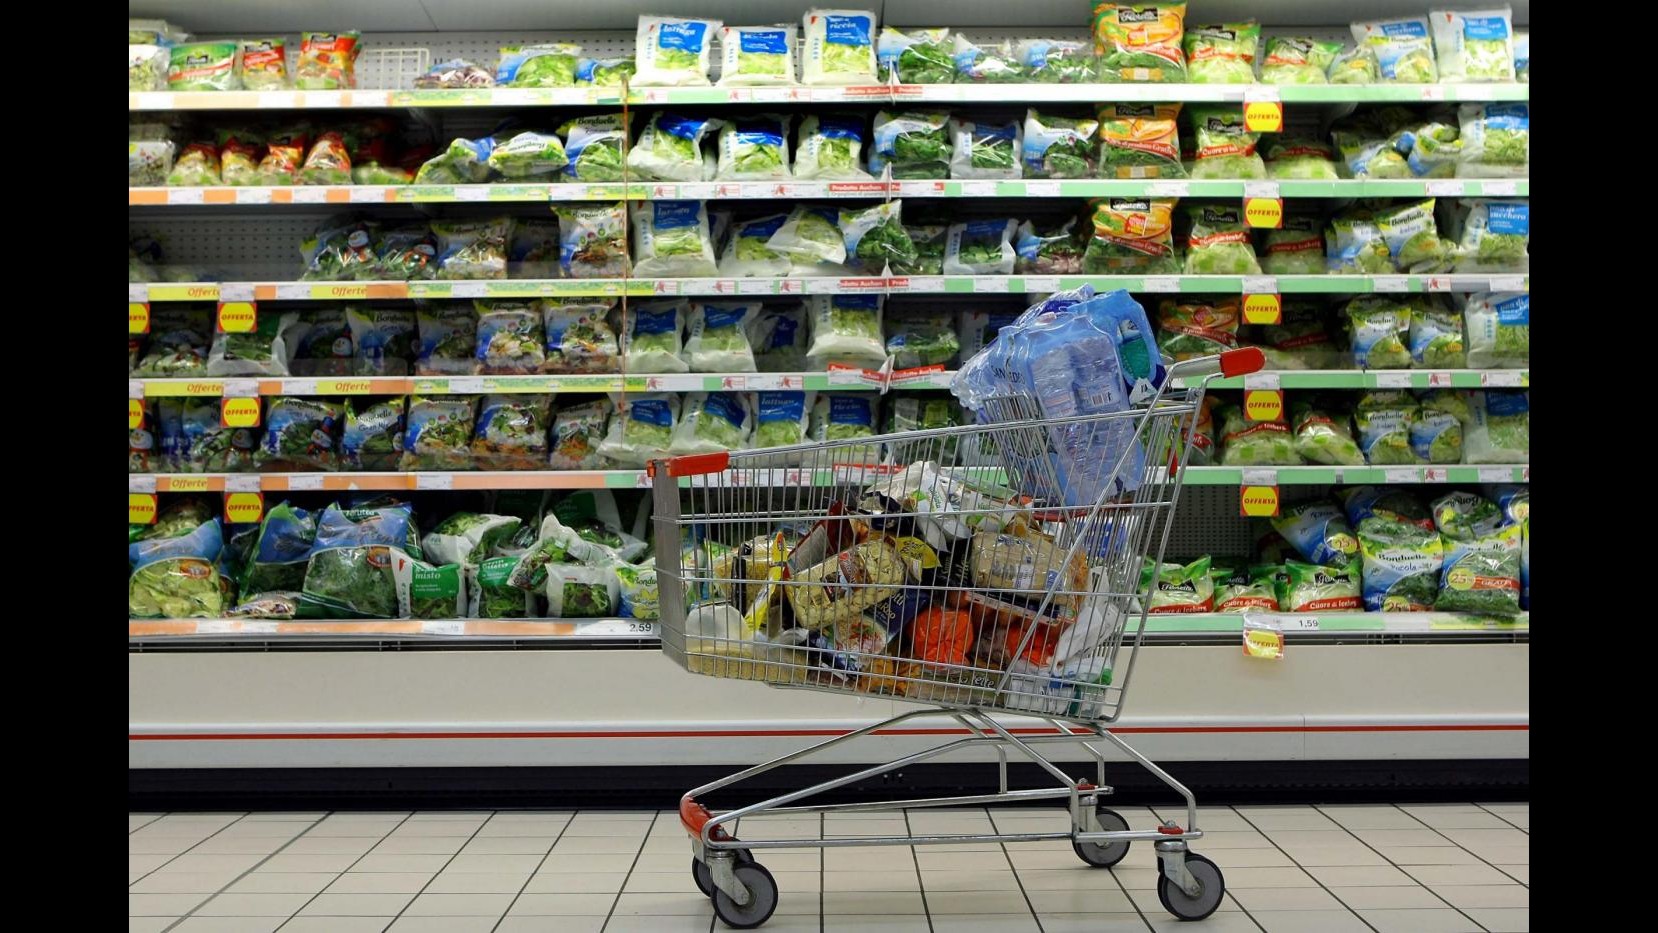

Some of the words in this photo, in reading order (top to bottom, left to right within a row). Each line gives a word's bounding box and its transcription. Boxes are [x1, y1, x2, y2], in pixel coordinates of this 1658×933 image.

[1247, 113, 1280, 121] OFFERTA
[1247, 208, 1280, 218] OFFERTA
[331, 286, 367, 297] Offerte
[1245, 304, 1279, 313] OFFERTA
[221, 314, 254, 322] OFFERTA
[186, 382, 223, 393] Offerte
[335, 381, 370, 392] Offerte
[1248, 402, 1280, 410] OFFERTA
[225, 408, 258, 416] OFFERTA
[171, 478, 208, 490] Offerte
[1244, 497, 1276, 506] OFFERTA
[228, 503, 261, 512] OFFERTA
[1378, 553, 1427, 564] Bonduelle
[415, 571, 441, 580] misto
[1309, 602, 1331, 610] Cuore
